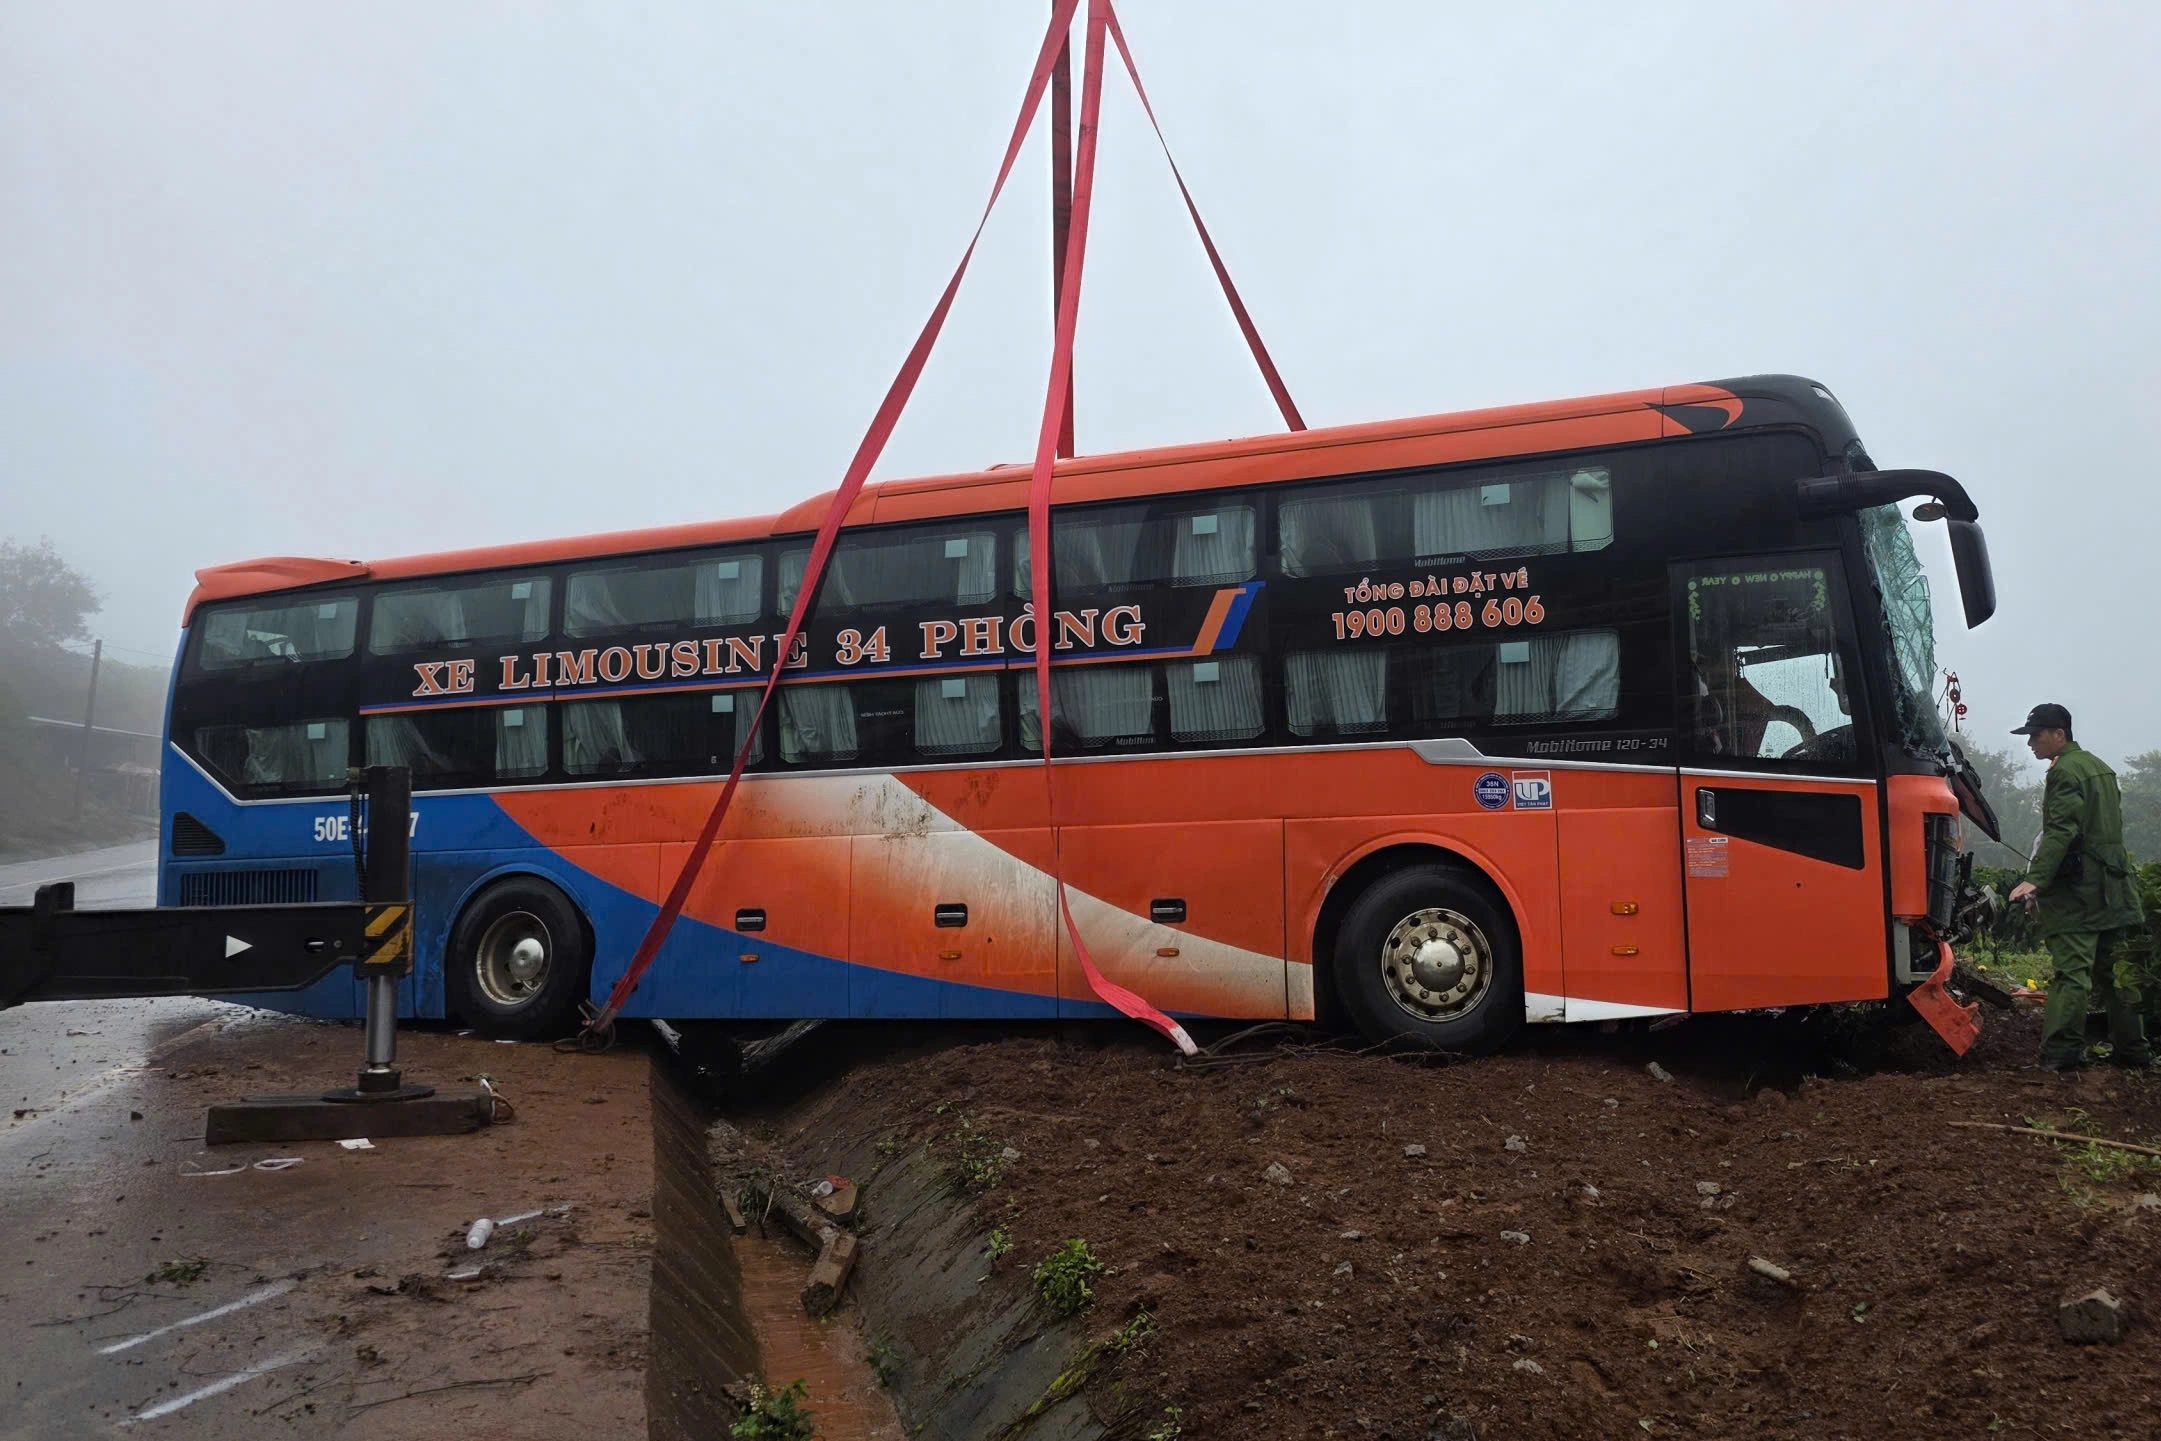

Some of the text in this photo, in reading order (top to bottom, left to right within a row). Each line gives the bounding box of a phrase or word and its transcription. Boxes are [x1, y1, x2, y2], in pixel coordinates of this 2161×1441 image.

[1344, 577, 1405, 603] TỔNG
[1409, 575, 1448, 598] ĐÀI
[1453, 571, 1497, 598] ĐẶT
[1332, 595, 1545, 640] 1900 888 606
[412, 603, 1146, 697] XE LIMOUSINE 34 PHÒNG
